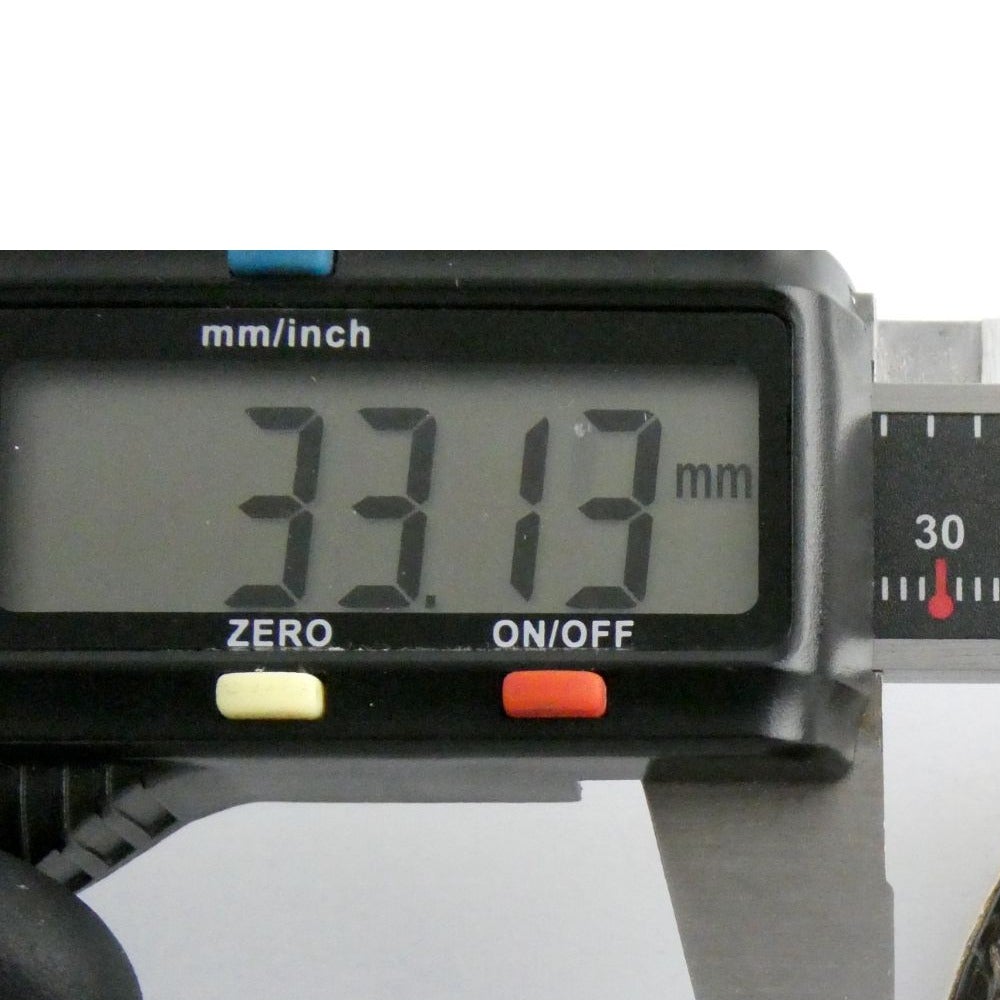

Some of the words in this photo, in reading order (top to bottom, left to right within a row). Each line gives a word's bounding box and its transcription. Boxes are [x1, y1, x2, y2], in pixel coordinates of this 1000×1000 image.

[200, 316, 372, 350] mm/inch
[224, 406, 662, 609] 33.13
[675, 462, 753, 500] mm
[913, 512, 966, 551] 30
[225, 618, 334, 649] ZERO
[491, 618, 636, 649] ON/OFF
